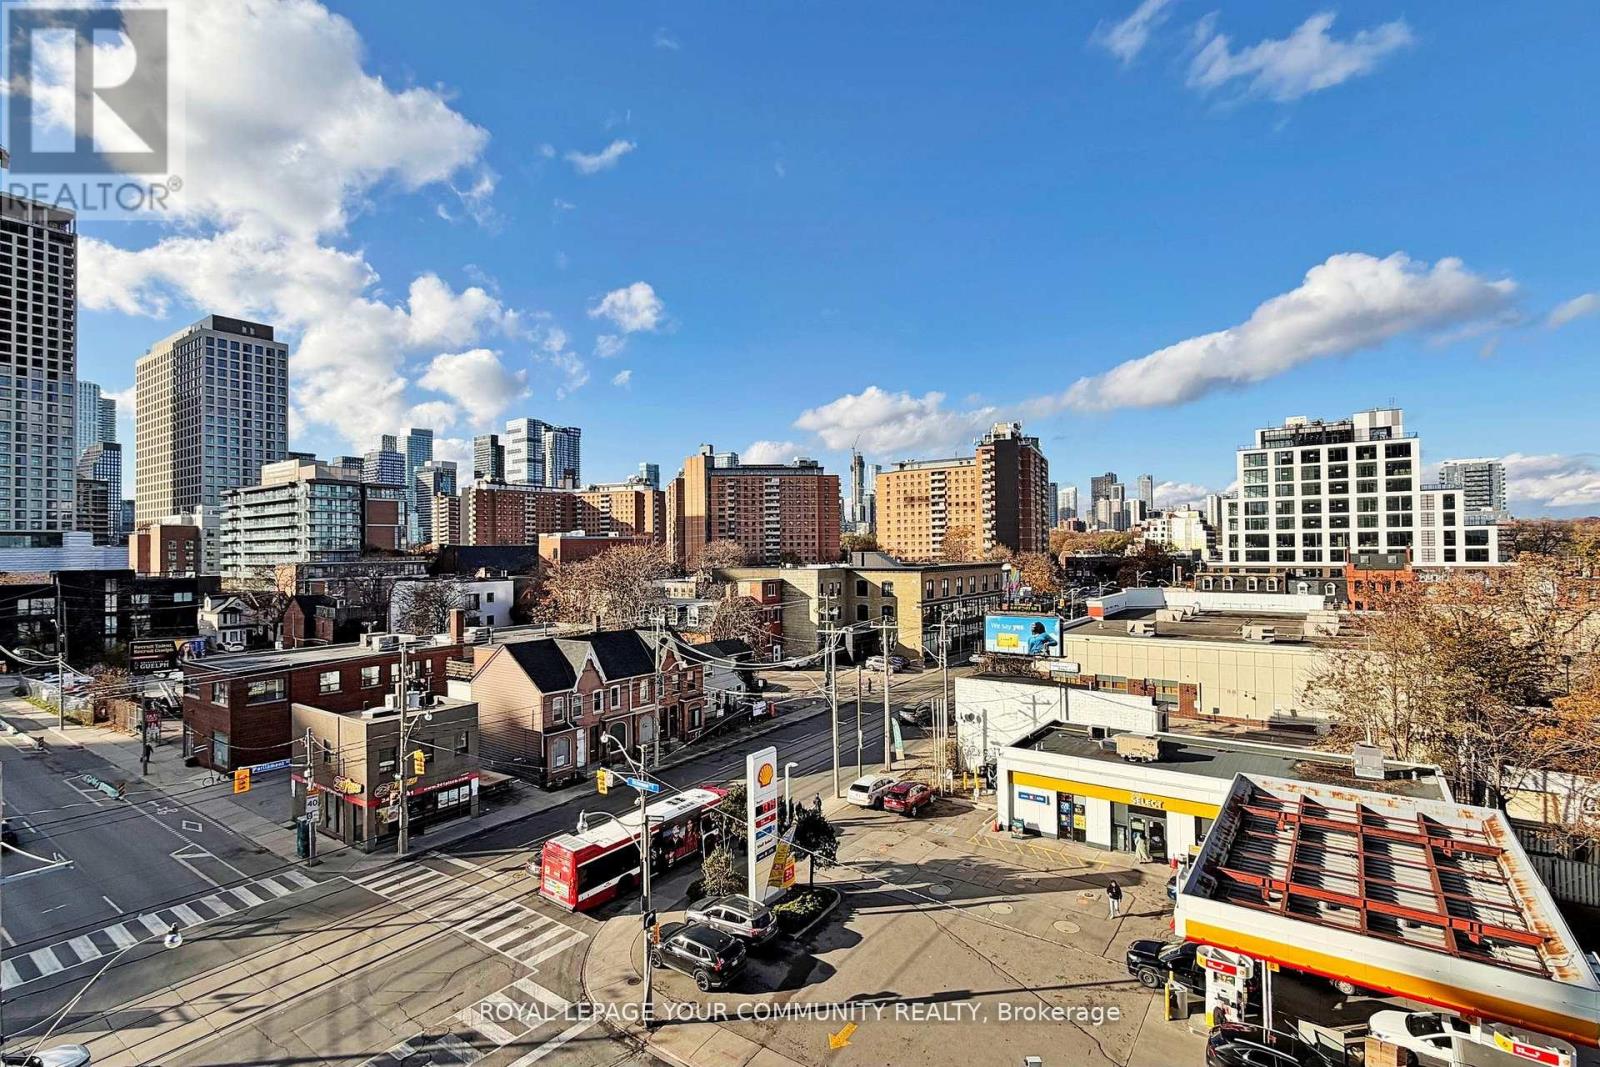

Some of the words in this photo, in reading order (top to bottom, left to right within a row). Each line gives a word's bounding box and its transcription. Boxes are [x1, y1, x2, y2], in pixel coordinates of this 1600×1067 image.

[991, 622, 1001, 630] We
[1012, 624, 1024, 632] yes
[140, 662, 169, 670] GUELPH
[307, 799, 318, 807] 40
